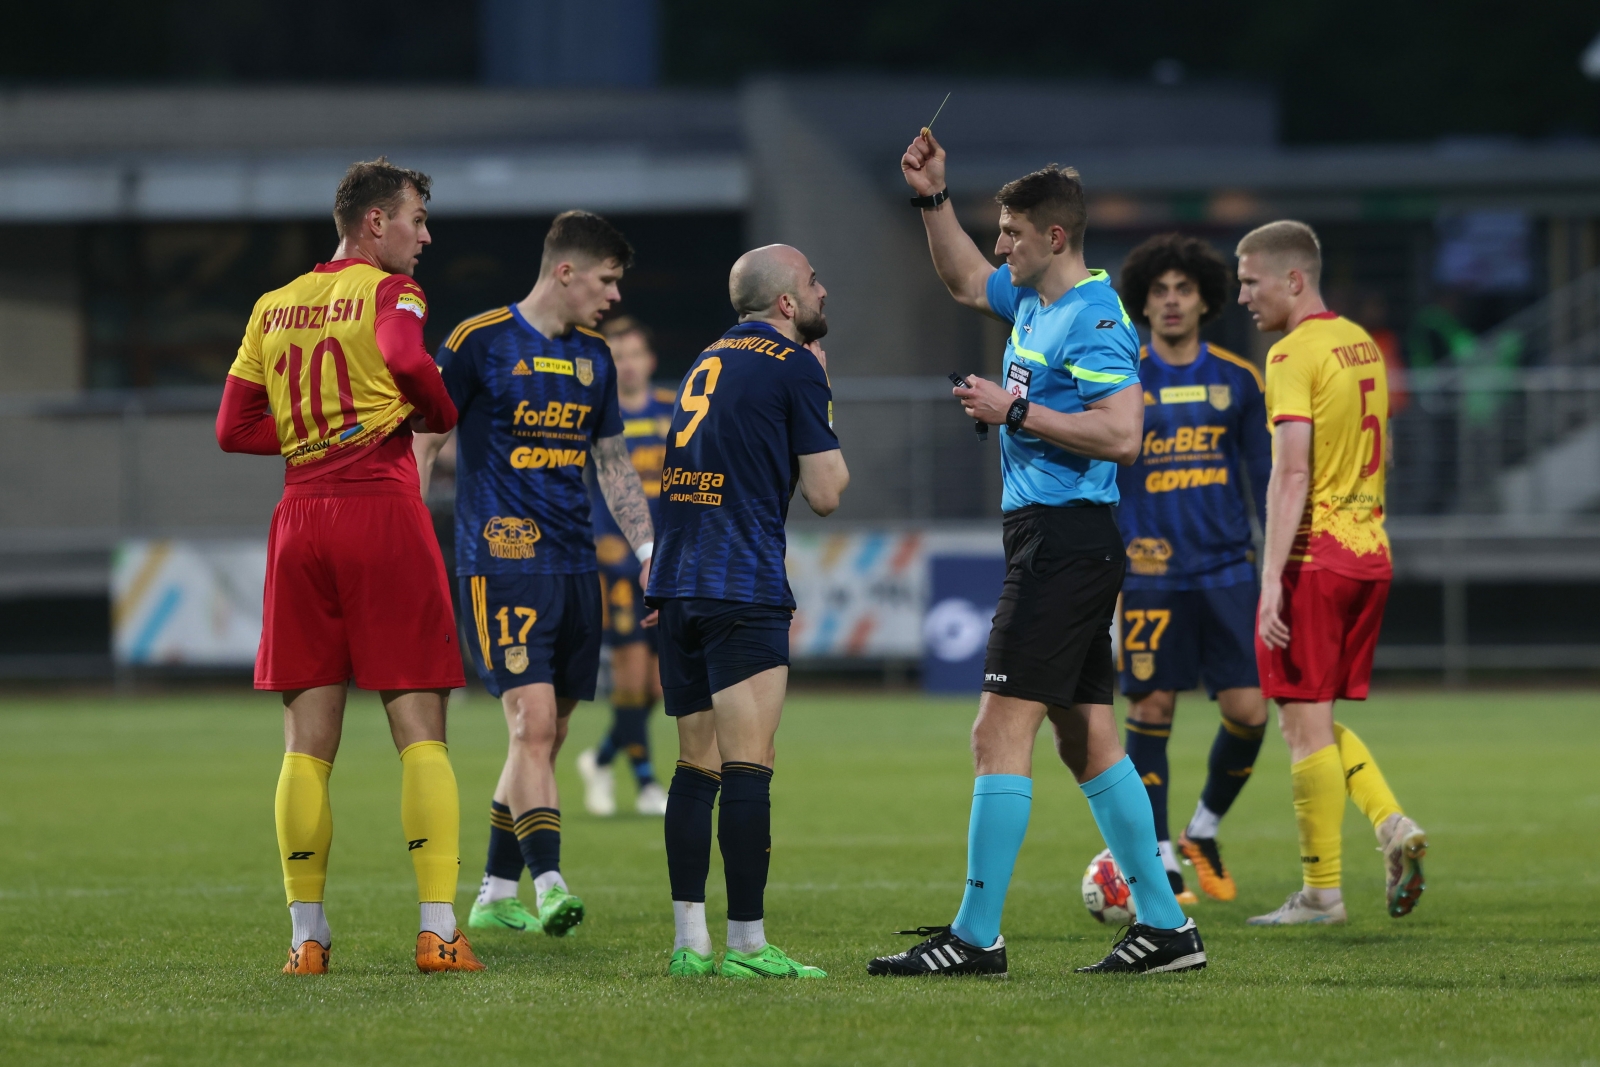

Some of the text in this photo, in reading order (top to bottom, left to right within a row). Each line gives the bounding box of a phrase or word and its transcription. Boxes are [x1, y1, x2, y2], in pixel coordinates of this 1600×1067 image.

[263, 298, 364, 334] GRUDZISKI
[535, 361, 572, 372] FORTUNA
[274, 337, 358, 440] 10
[675, 356, 722, 448] 9
[513, 400, 591, 430] forBET
[1358, 378, 1381, 478] 5
[1143, 425, 1227, 456] forBET
[510, 446, 586, 469] GDYNIA
[672, 467, 725, 491] Energa
[1145, 467, 1228, 494] GDYNIA
[670, 493, 720, 504] GRUPA ORLEN
[495, 606, 537, 646] 17
[1124, 609, 1171, 650] 27
[967, 878, 984, 889] na
[1084, 891, 1098, 904] ECT
